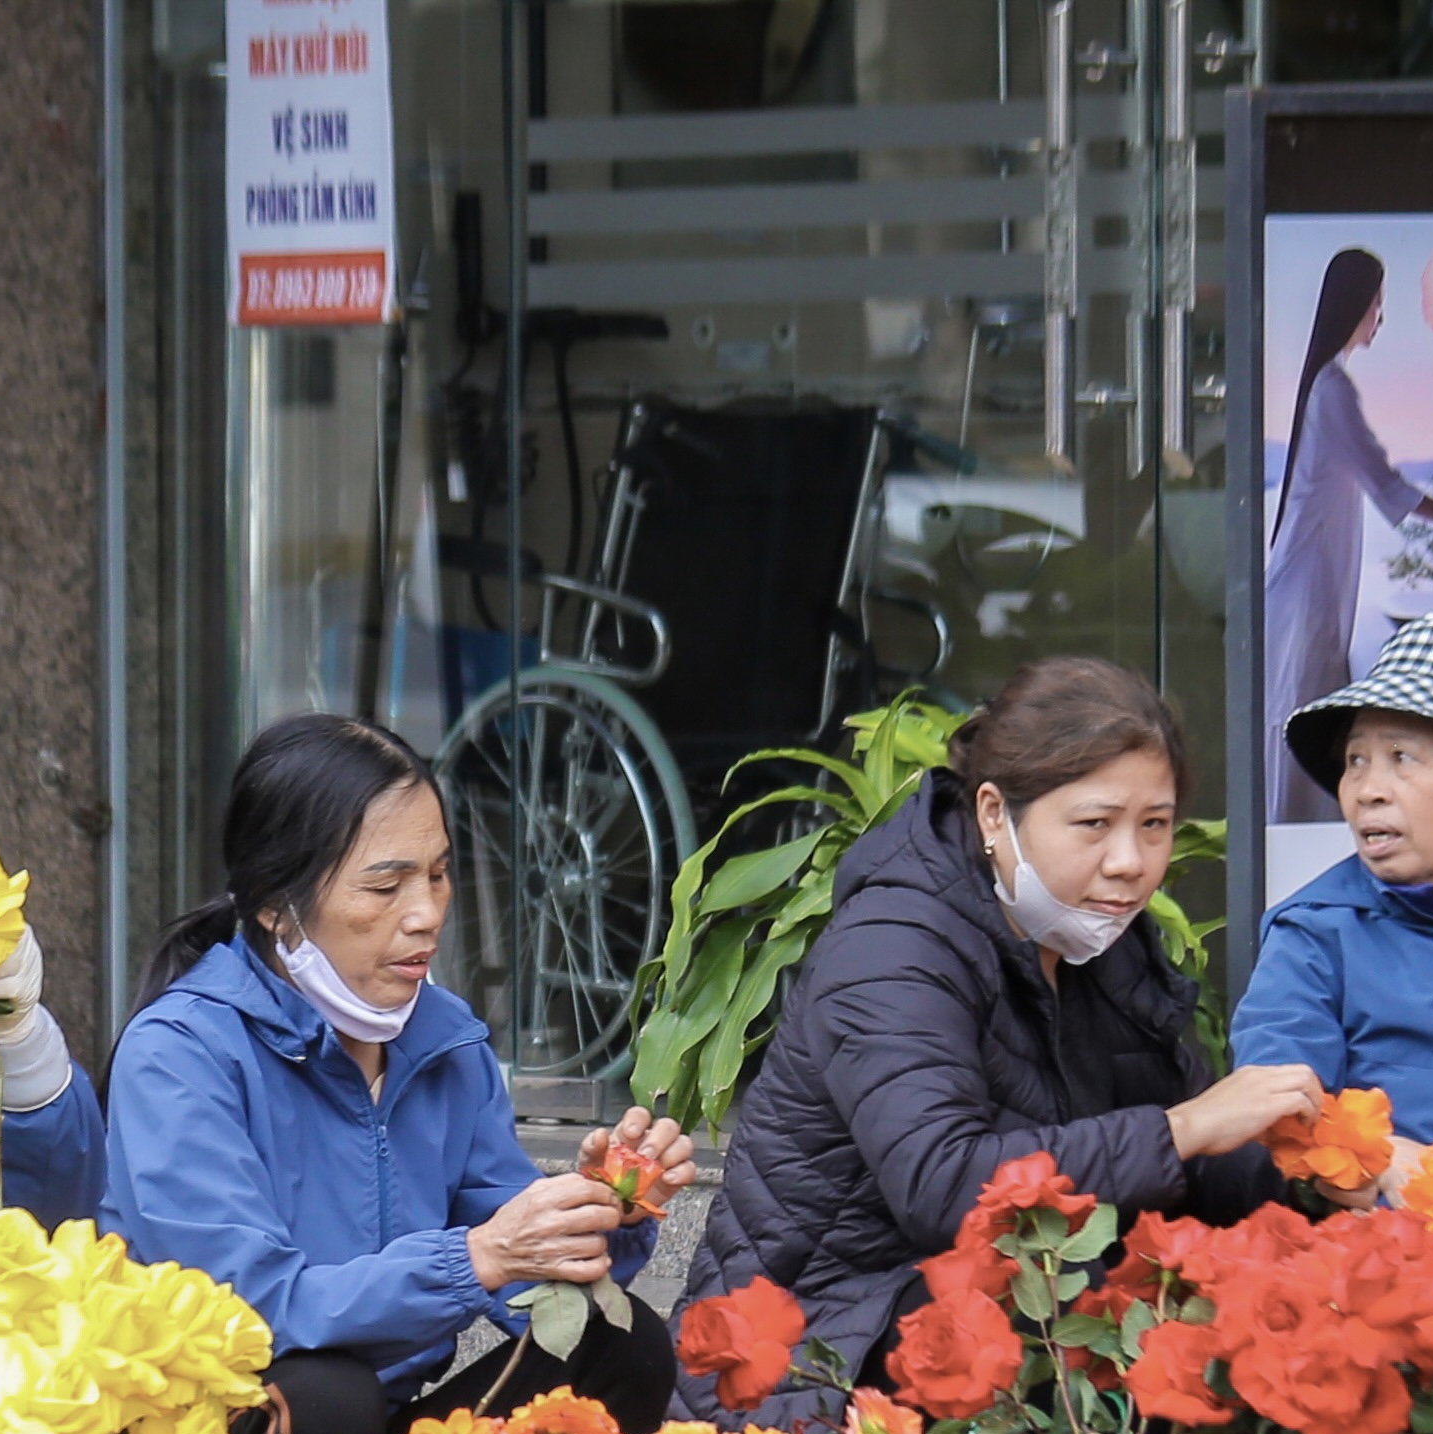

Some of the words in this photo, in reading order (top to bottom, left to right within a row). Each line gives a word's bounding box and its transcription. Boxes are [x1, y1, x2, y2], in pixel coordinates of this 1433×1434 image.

[272, 100, 293, 162] VỆ
[302, 108, 348, 154] SINH
[339, 174, 375, 223] KÍNH
